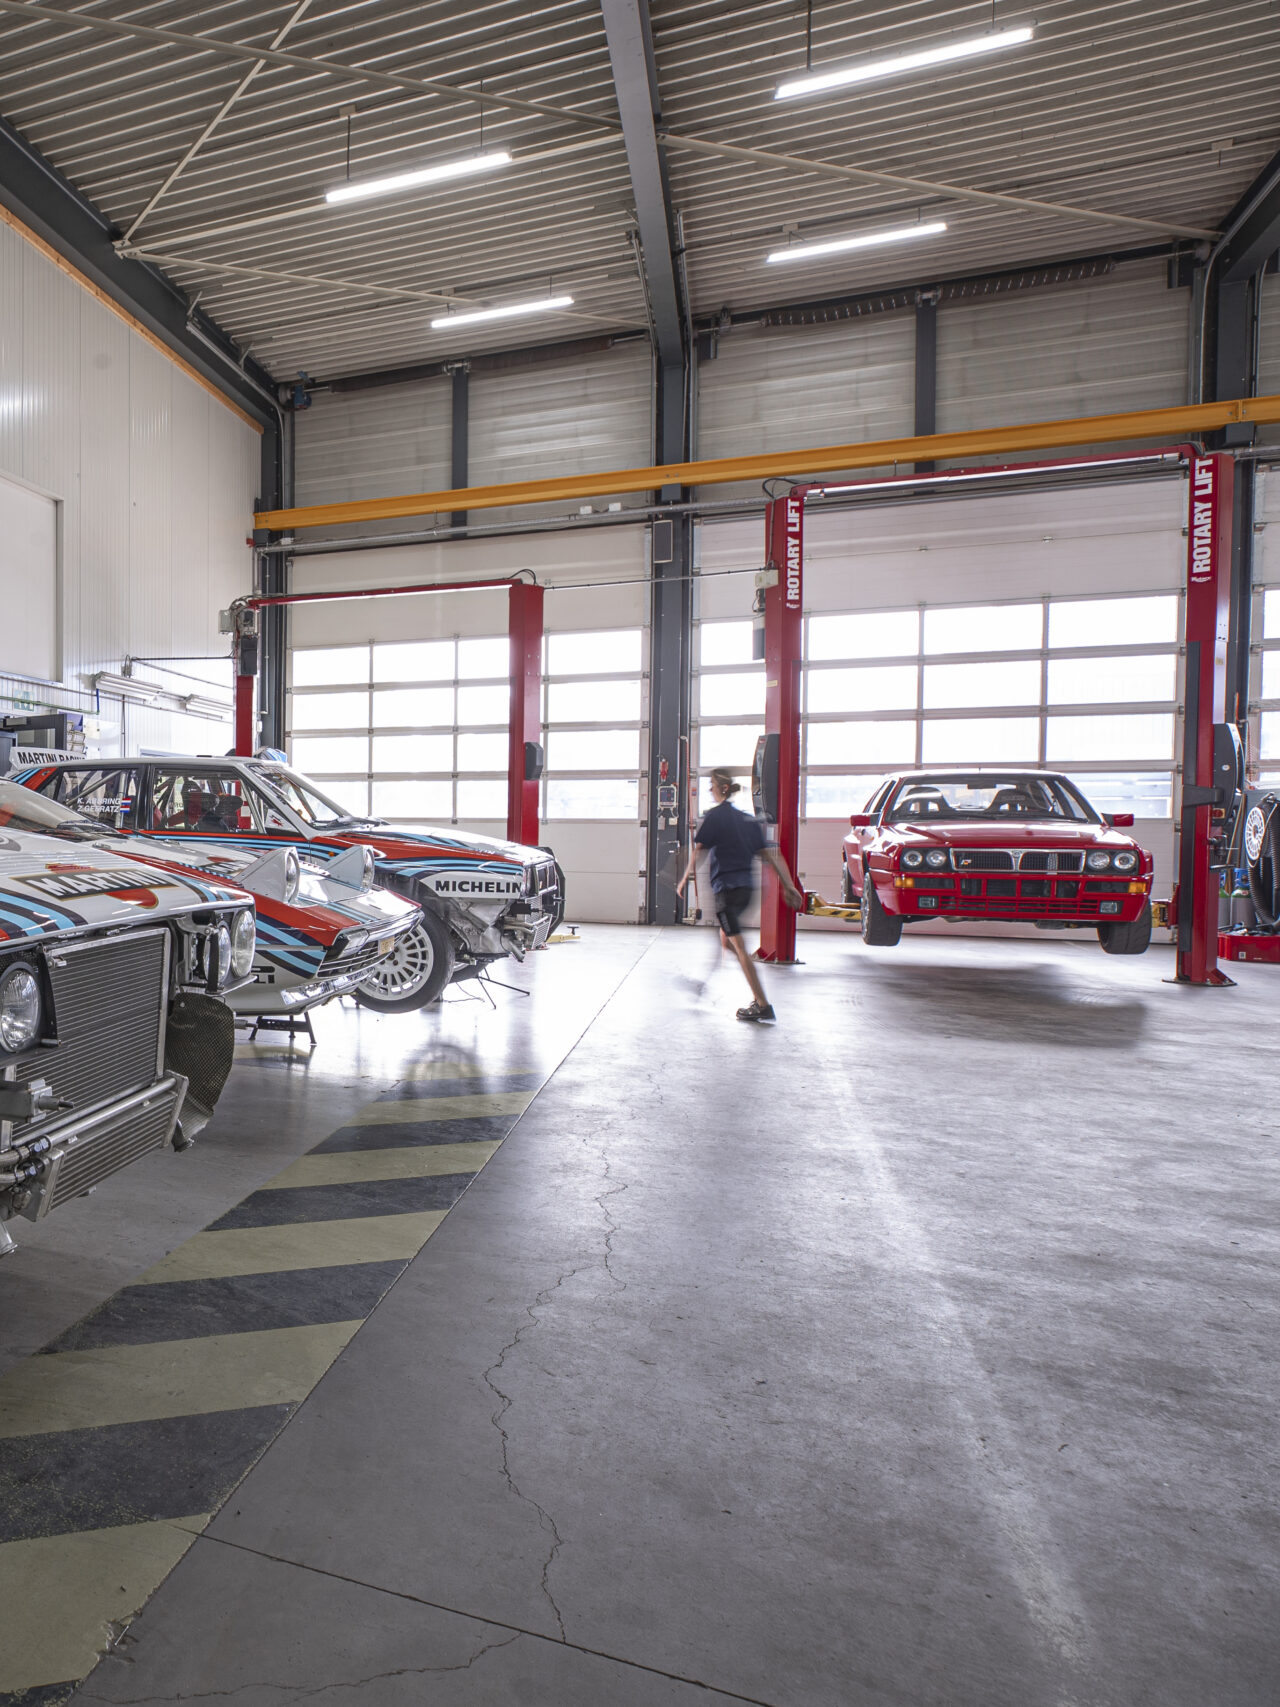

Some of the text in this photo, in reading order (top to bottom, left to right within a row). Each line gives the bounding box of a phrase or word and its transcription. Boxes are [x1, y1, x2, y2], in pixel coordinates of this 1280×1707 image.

[1194, 458, 1213, 497] LIFT
[787, 499, 800, 532] LIFT
[1192, 501, 1212, 573] ROTARY
[787, 536, 800, 600] ROTARY
[17, 752, 57, 764] MARTINI
[25, 868, 169, 897] MARTINI
[435, 881, 521, 893] MICHELIN
